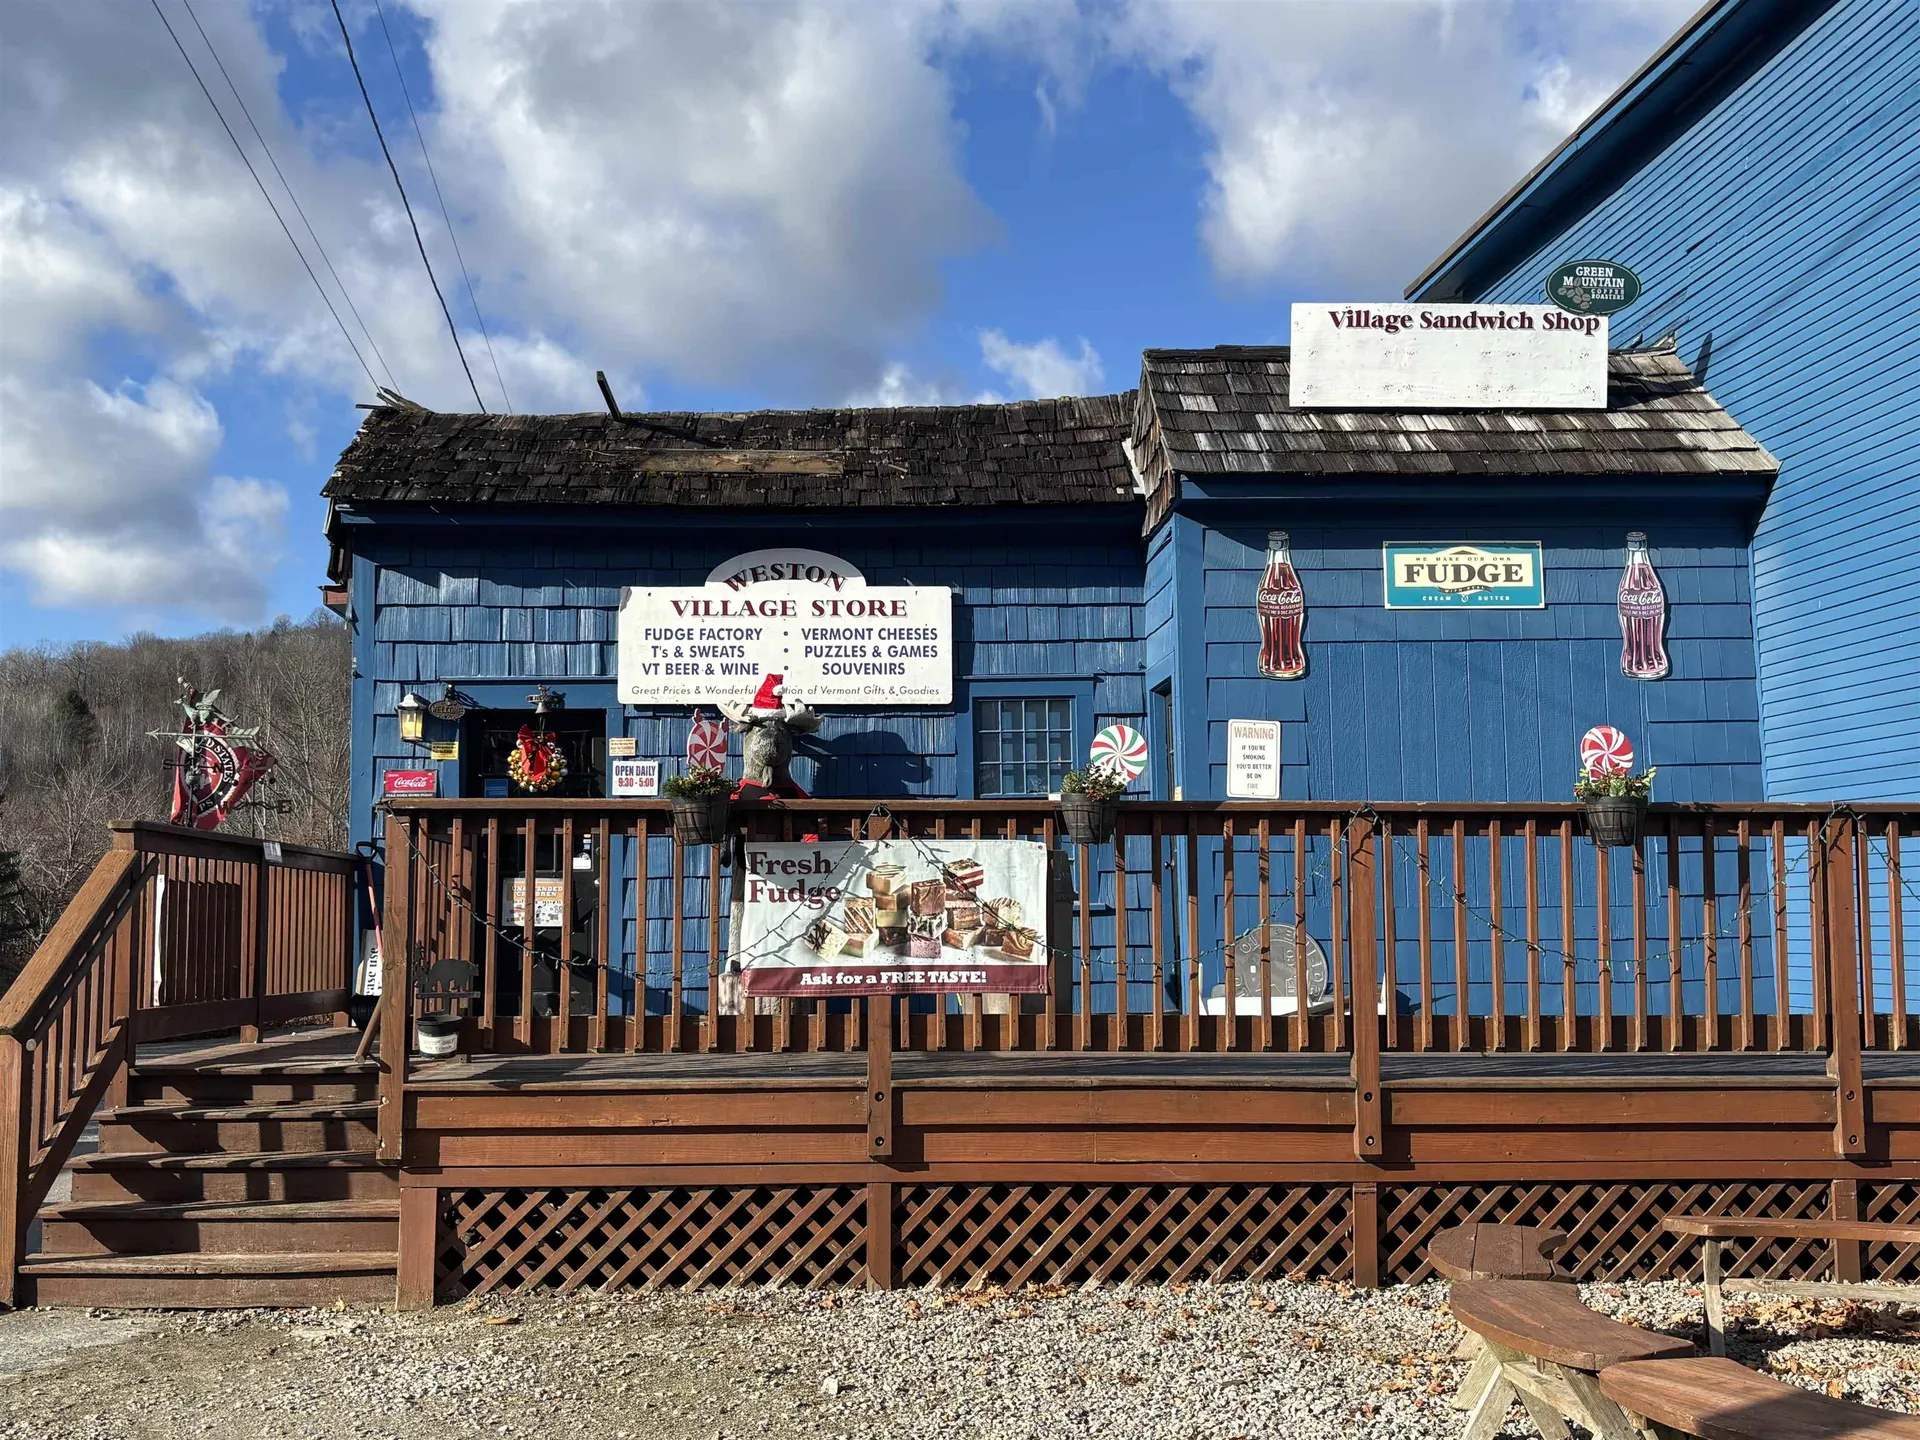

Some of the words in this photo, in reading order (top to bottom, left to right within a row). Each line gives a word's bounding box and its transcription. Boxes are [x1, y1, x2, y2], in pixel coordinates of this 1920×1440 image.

[1576, 266, 1613, 277] GREEN
[1328, 310, 1412, 333] Village
[1420, 310, 1534, 330] Sandwich
[1542, 312, 1601, 336] Shop
[723, 562, 848, 593] WESTON
[1404, 564, 1523, 583] FUDGE
[670, 599, 797, 618] VILLAGE
[812, 599, 908, 618] STORE
[644, 628, 695, 642] FUDGE
[699, 628, 763, 642] FACTORY
[802, 628, 873, 642] VERMONT
[878, 628, 938, 642] CHEESES
[651, 645, 668, 658] T's
[674, 645, 684, 659] &
[689, 646, 745, 659] SWEATS
[804, 645, 867, 659] PUZZLES
[872, 645, 882, 658] &
[887, 645, 938, 659] GAMES
[642, 663, 661, 676] VT
[665, 663, 700, 676] BEER
[705, 663, 715, 676] &
[720, 663, 760, 676] WINE
[822, 663, 905, 676] SOUVENIRS
[631, 685, 660, 695] Great
[662, 685, 691, 695] Prices
[694, 685, 701, 695] &
[705, 685, 757, 695] Wonderful
[807, 684, 818, 695] of
[820, 685, 860, 695] Vermont
[863, 684, 885, 695] Gifts
[888, 685, 896, 695] &
[899, 685, 940, 695] Goodies
[1234, 726, 1274, 739] WARNING
[214, 745, 233, 782] STATES
[615, 765, 634, 776] OPEN
[636, 765, 656, 776] DAILY
[618, 778, 634, 787] 9:30
[638, 778, 654, 787] 5:00
[749, 851, 832, 875] Fresh
[749, 879, 841, 909] Fudge
[369, 947, 379, 967] use
[801, 972, 832, 985] Ask
[835, 971, 863, 985] for
[867, 975, 877, 984] a
[880, 971, 925, 984] FREE
[927, 970, 986, 984] TASTE!
